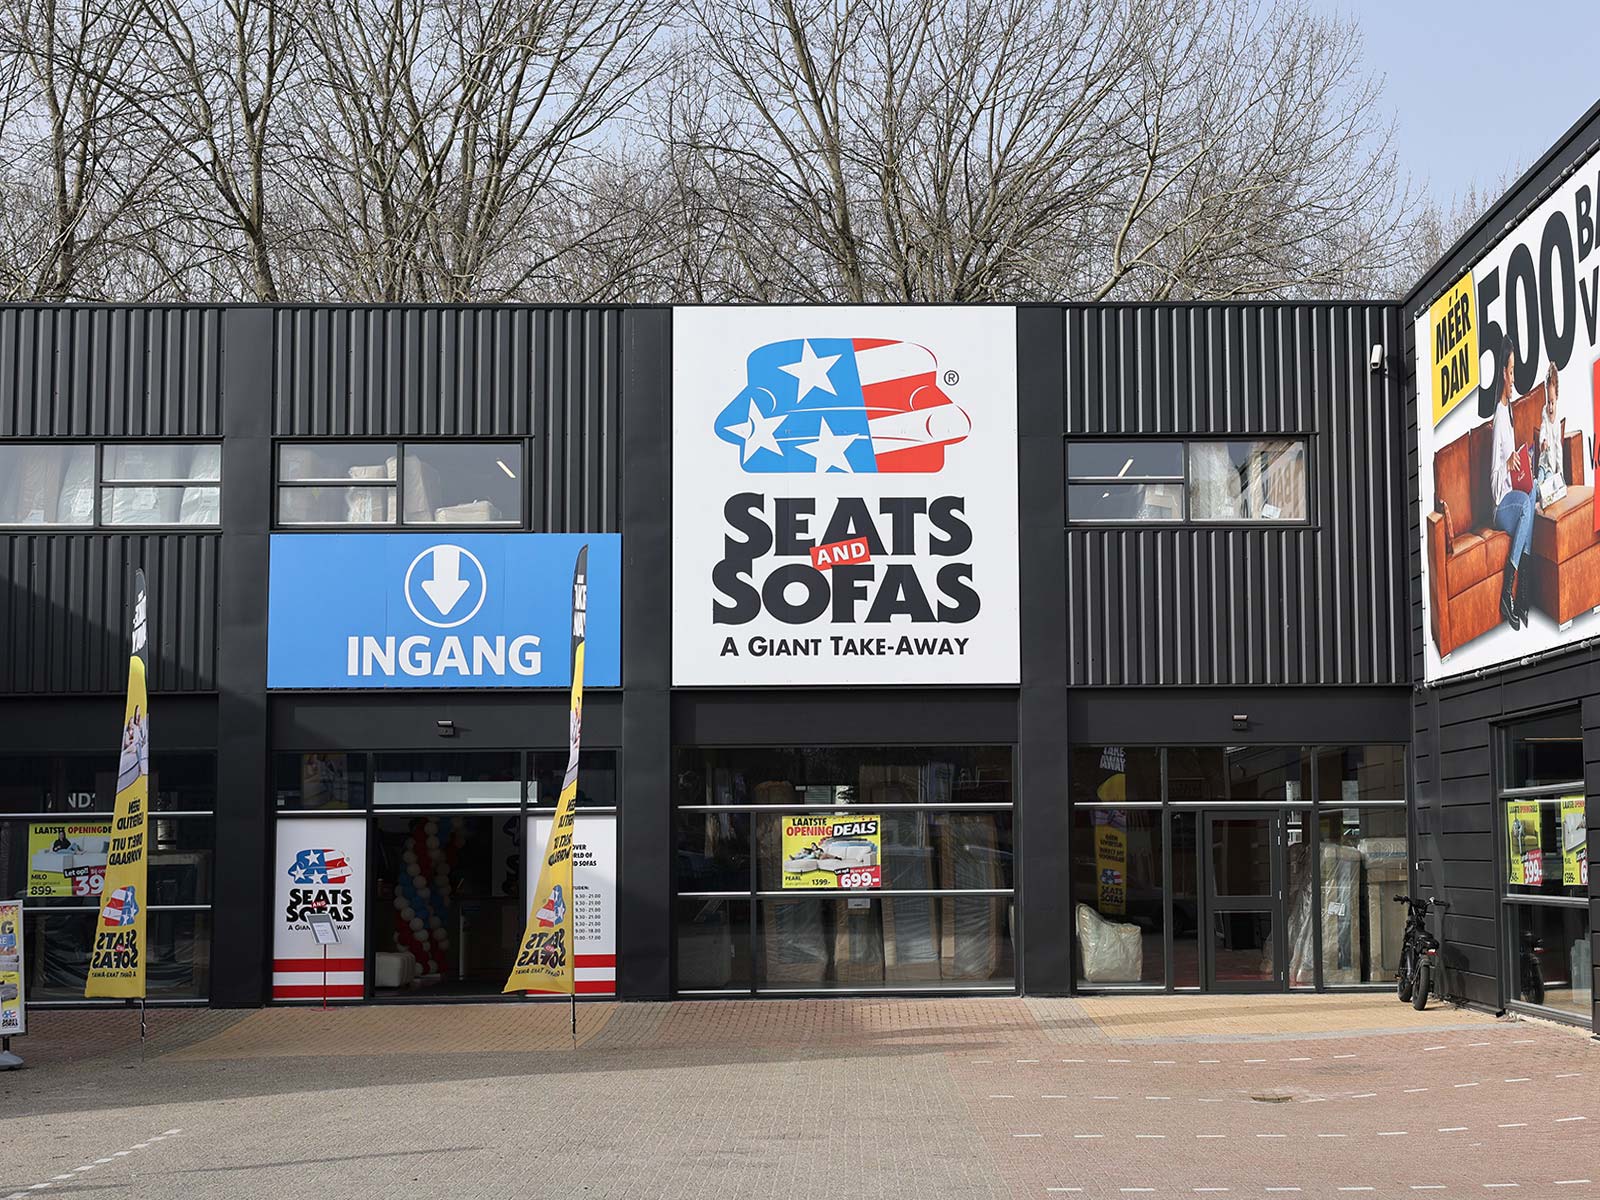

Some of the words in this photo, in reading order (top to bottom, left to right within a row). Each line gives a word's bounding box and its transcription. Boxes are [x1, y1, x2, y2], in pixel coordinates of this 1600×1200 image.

[1575, 171, 1600, 263] B
[1436, 288, 1471, 365] MÉÉR
[1478, 210, 1576, 419] 500
[1441, 343, 1470, 407] DAN
[724, 492, 973, 559] SEATS
[816, 541, 867, 567] AND
[712, 558, 981, 625] SOFAS
[347, 635, 542, 676] INGANG
[720, 637, 739, 656] A
[748, 636, 822, 656] GIANT
[830, 635, 969, 656] TAKE-AWAY
[34, 826, 65, 834] LAATSTE
[786, 826, 832, 837] OPENING
[833, 822, 877, 836] DEALS
[792, 818, 827, 826] LAATSTE
[841, 872, 880, 887] 699.-
[289, 889, 352, 905] SEATS
